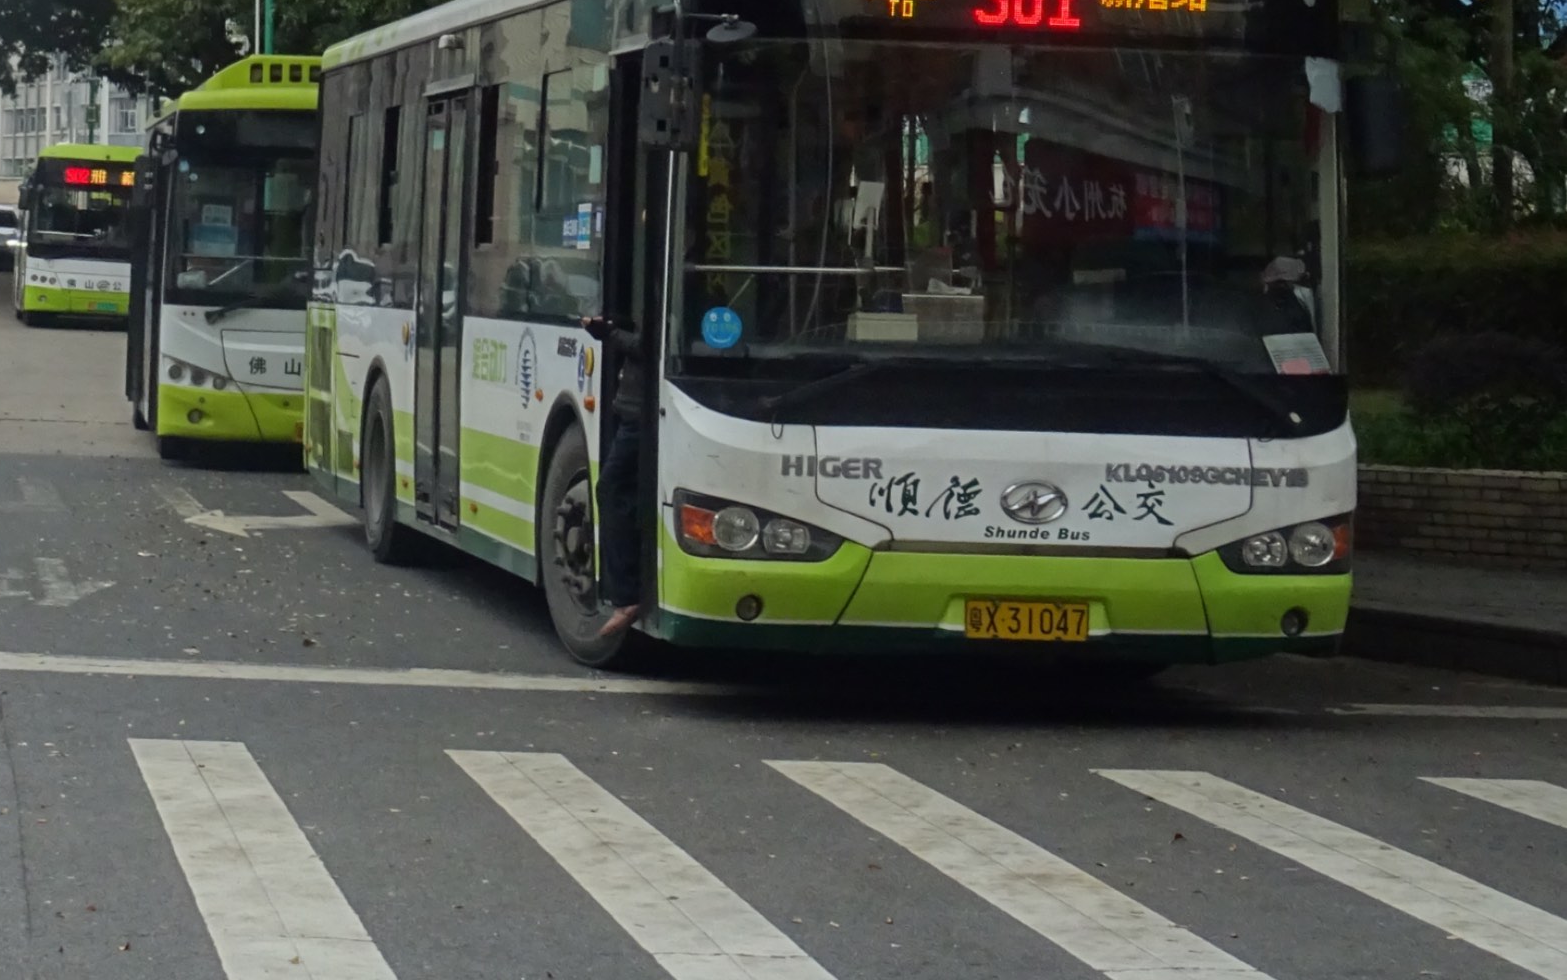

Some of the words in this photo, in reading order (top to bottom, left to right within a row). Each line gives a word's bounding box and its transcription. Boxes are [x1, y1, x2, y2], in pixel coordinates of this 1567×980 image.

[889, 0, 914, 18] TO
[249, 356, 302, 376] 佛山
[781, 454, 884, 480] HIGER
[1080, 480, 1175, 526] 公交
[984, 525, 1050, 540] Shunde
[1057, 527, 1091, 541] Bus
